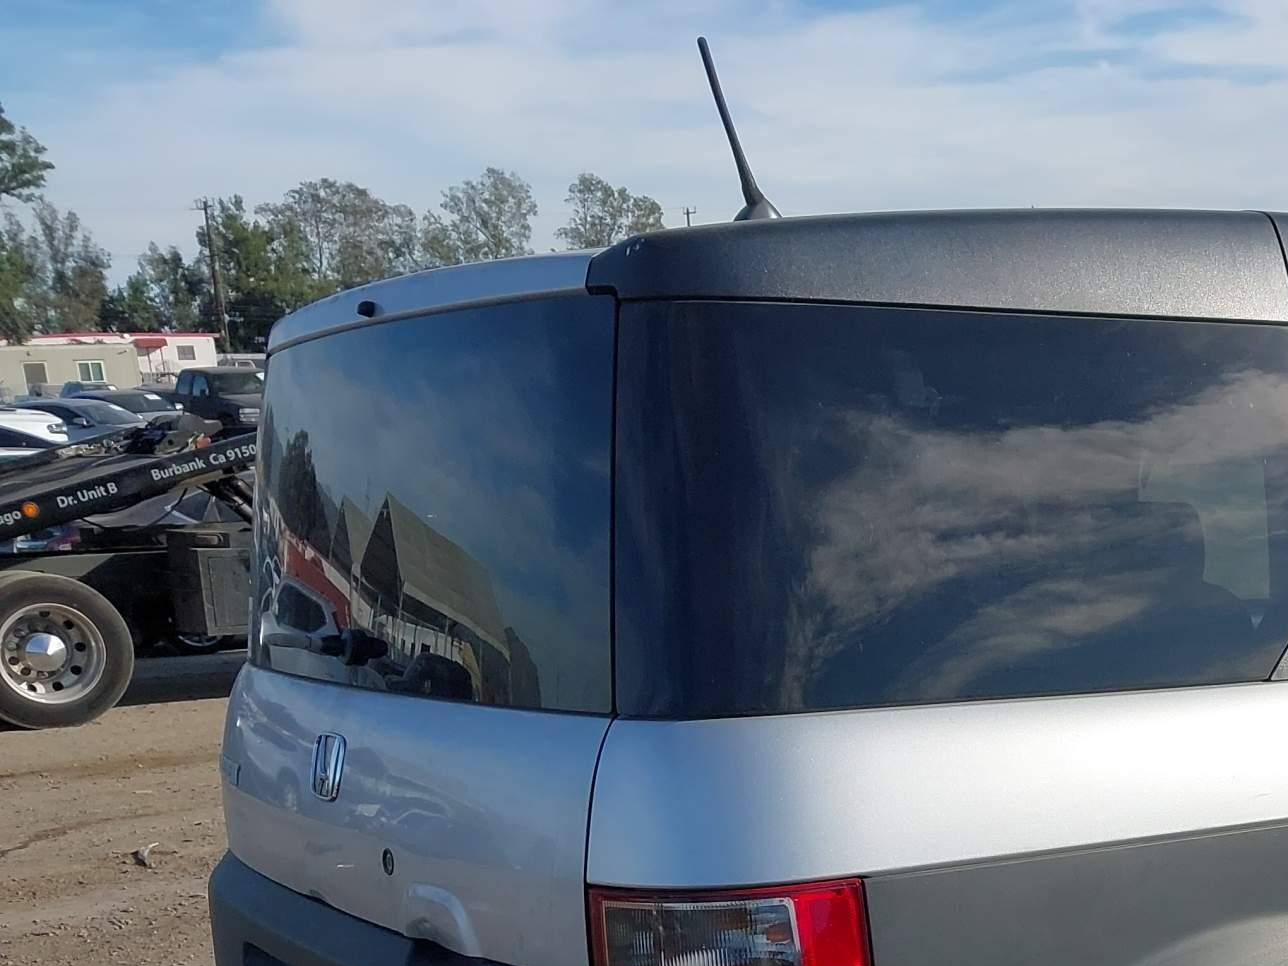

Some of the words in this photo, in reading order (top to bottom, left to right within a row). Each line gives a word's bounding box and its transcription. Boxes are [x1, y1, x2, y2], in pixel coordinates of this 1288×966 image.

[56, 495, 78, 509] Dr.
[78, 485, 106, 502] Unit
[108, 482, 119, 495] B
[151, 457, 206, 481] Burbank
[209, 453, 226, 465] Ca
